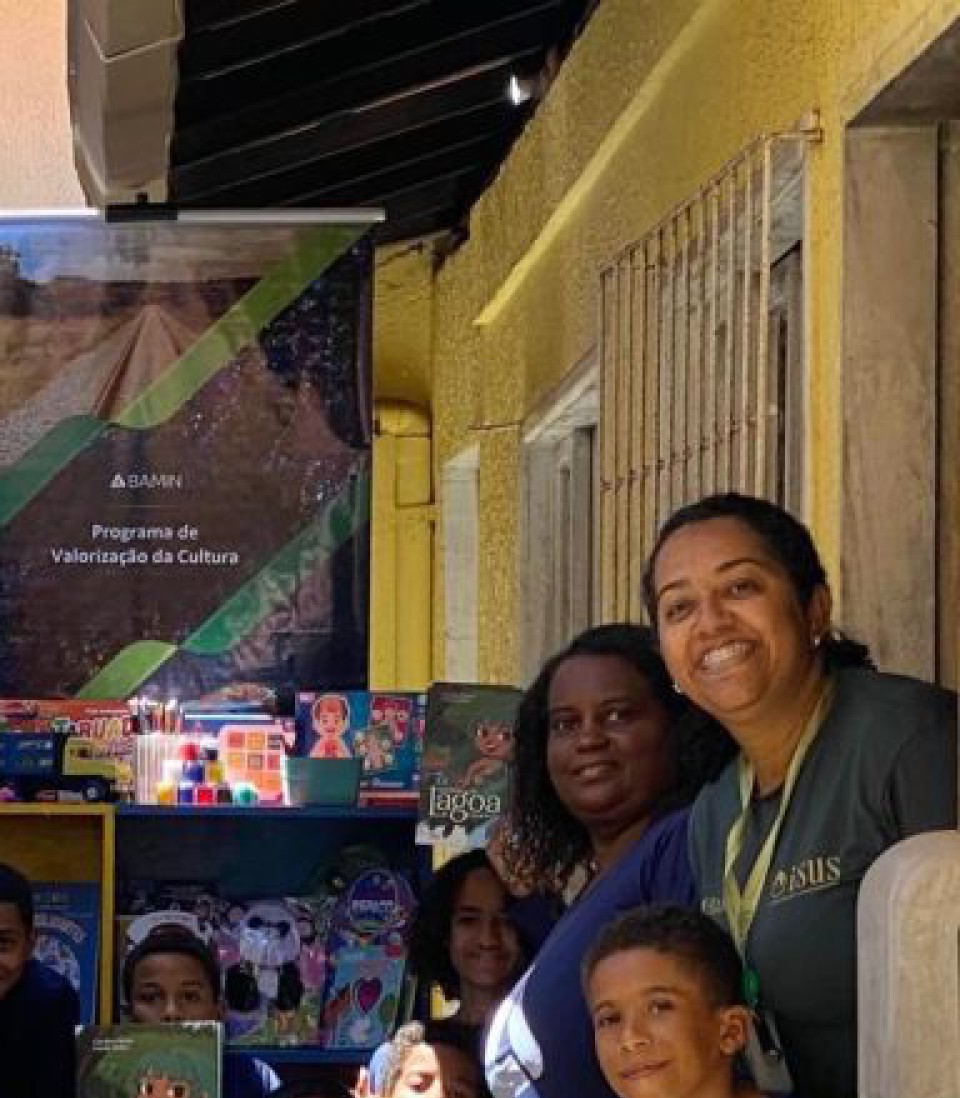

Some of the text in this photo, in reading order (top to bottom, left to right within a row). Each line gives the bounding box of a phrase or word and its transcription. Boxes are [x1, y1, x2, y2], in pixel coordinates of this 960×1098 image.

[91, 524, 199, 543] Programa de
[50, 547, 240, 567] Valorização da Cultura
